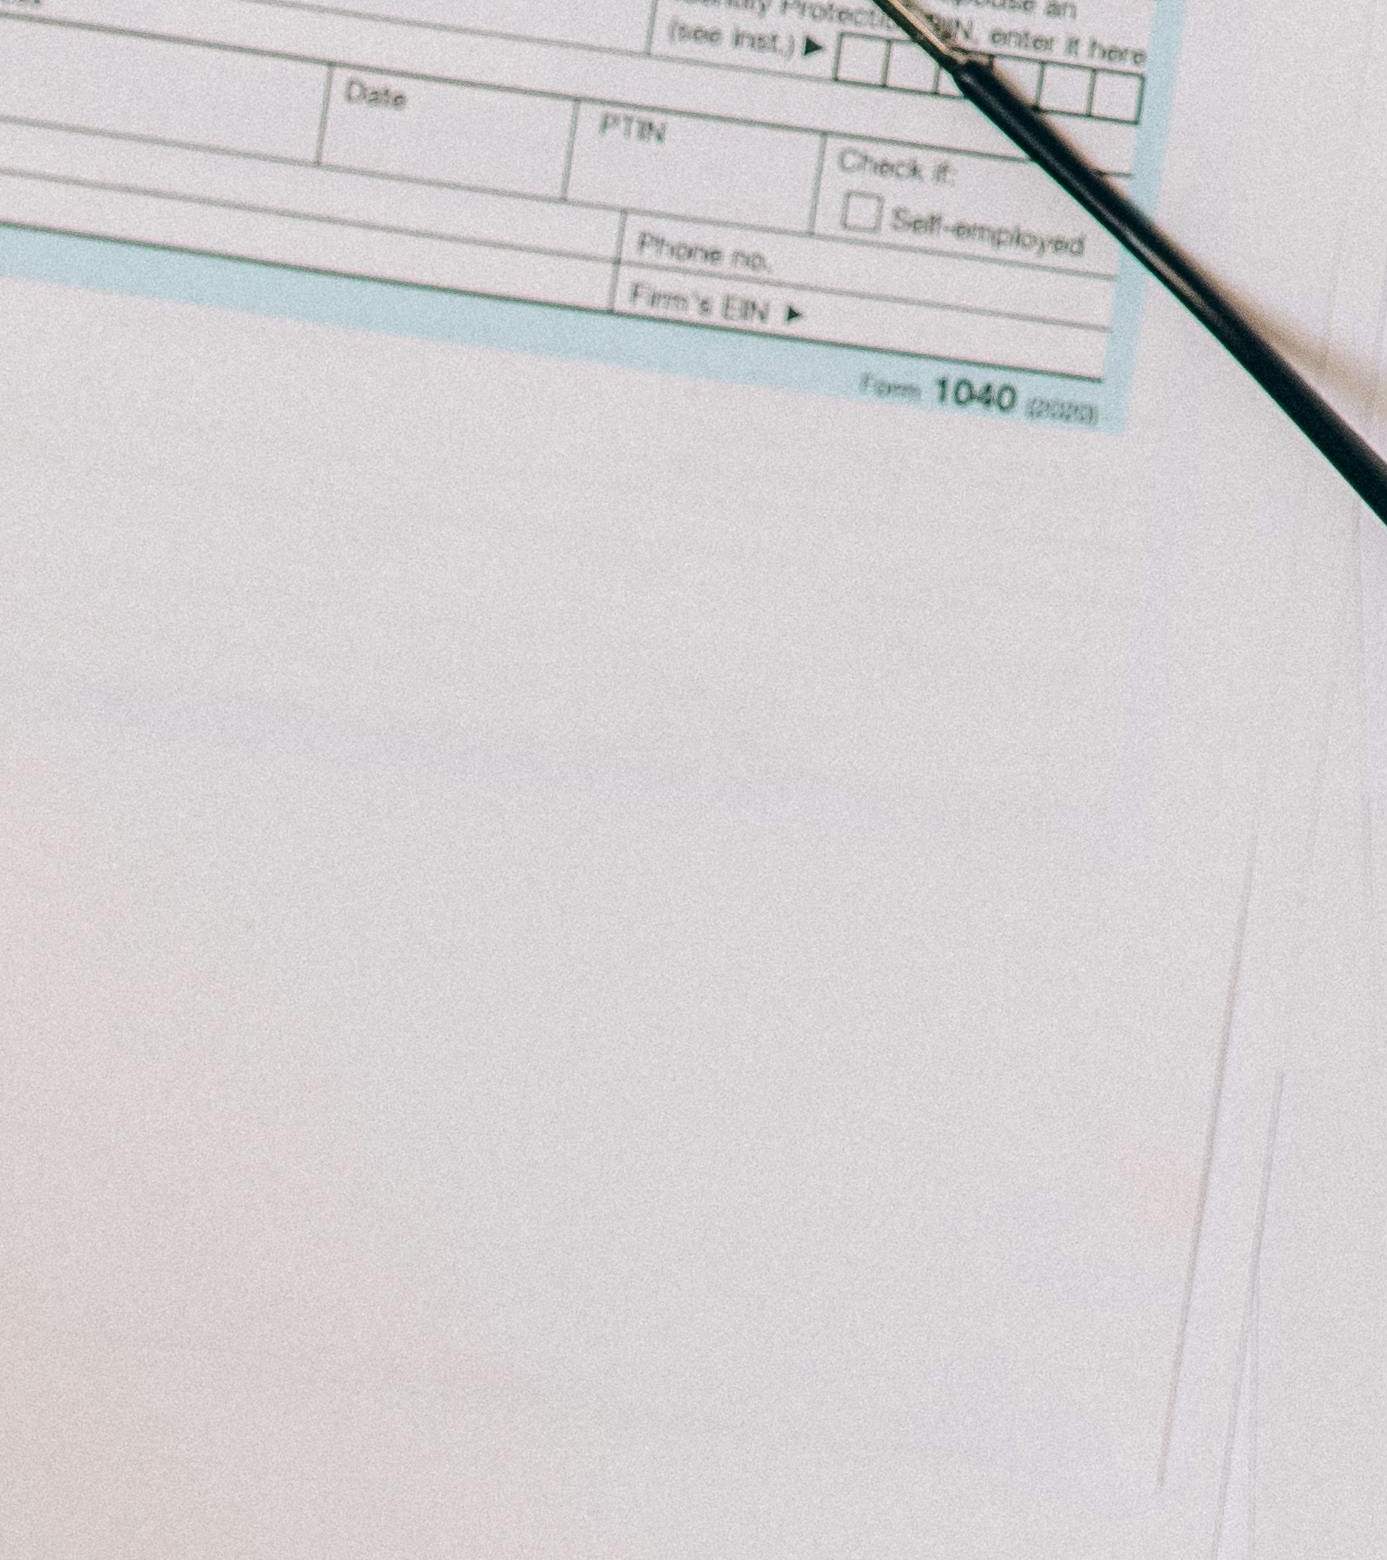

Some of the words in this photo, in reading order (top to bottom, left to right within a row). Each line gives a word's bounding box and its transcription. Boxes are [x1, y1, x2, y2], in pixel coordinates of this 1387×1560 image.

[345, 79, 407, 109] Date
[838, 148, 923, 180] Check
[892, 207, 1086, 257] Self-employed
[937, 378, 1017, 413] 1040
